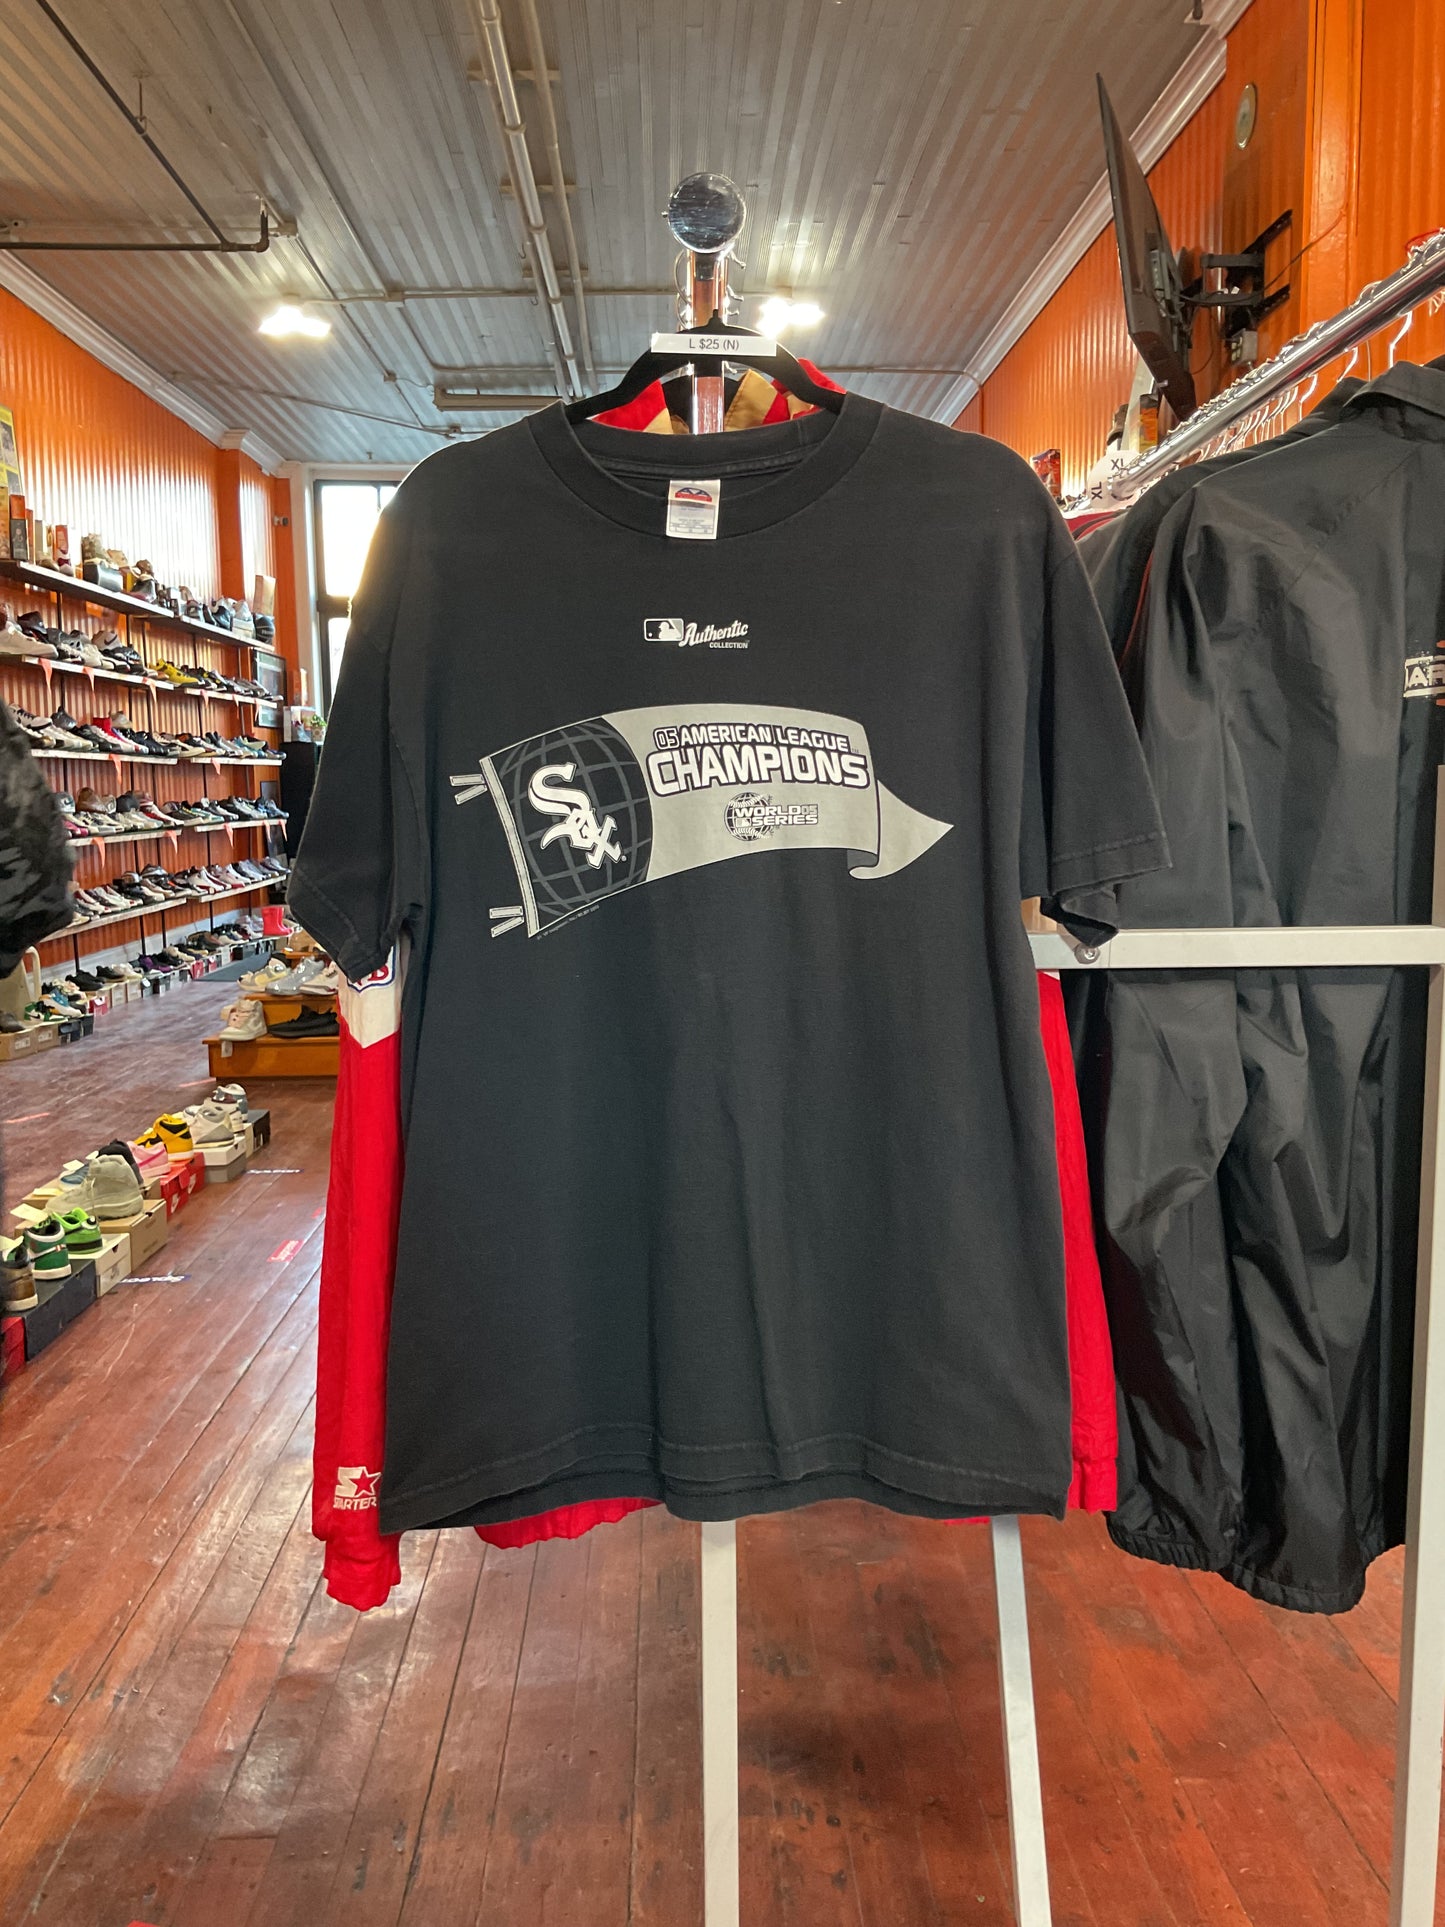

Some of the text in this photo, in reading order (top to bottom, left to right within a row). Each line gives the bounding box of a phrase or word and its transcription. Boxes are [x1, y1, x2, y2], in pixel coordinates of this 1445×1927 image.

[689, 338, 739, 351] L $25 (N)
[1091, 481, 1102, 500] XL
[679, 620, 748, 646] Authentic
[709, 641, 748, 649] COLLECTION
[653, 724, 850, 752] 05 AMERICAN LEAGUE
[647, 745, 869, 796] CHAMPIONS
[733, 803, 818, 818] WORLD 05
[751, 814, 818, 827] SERIES
